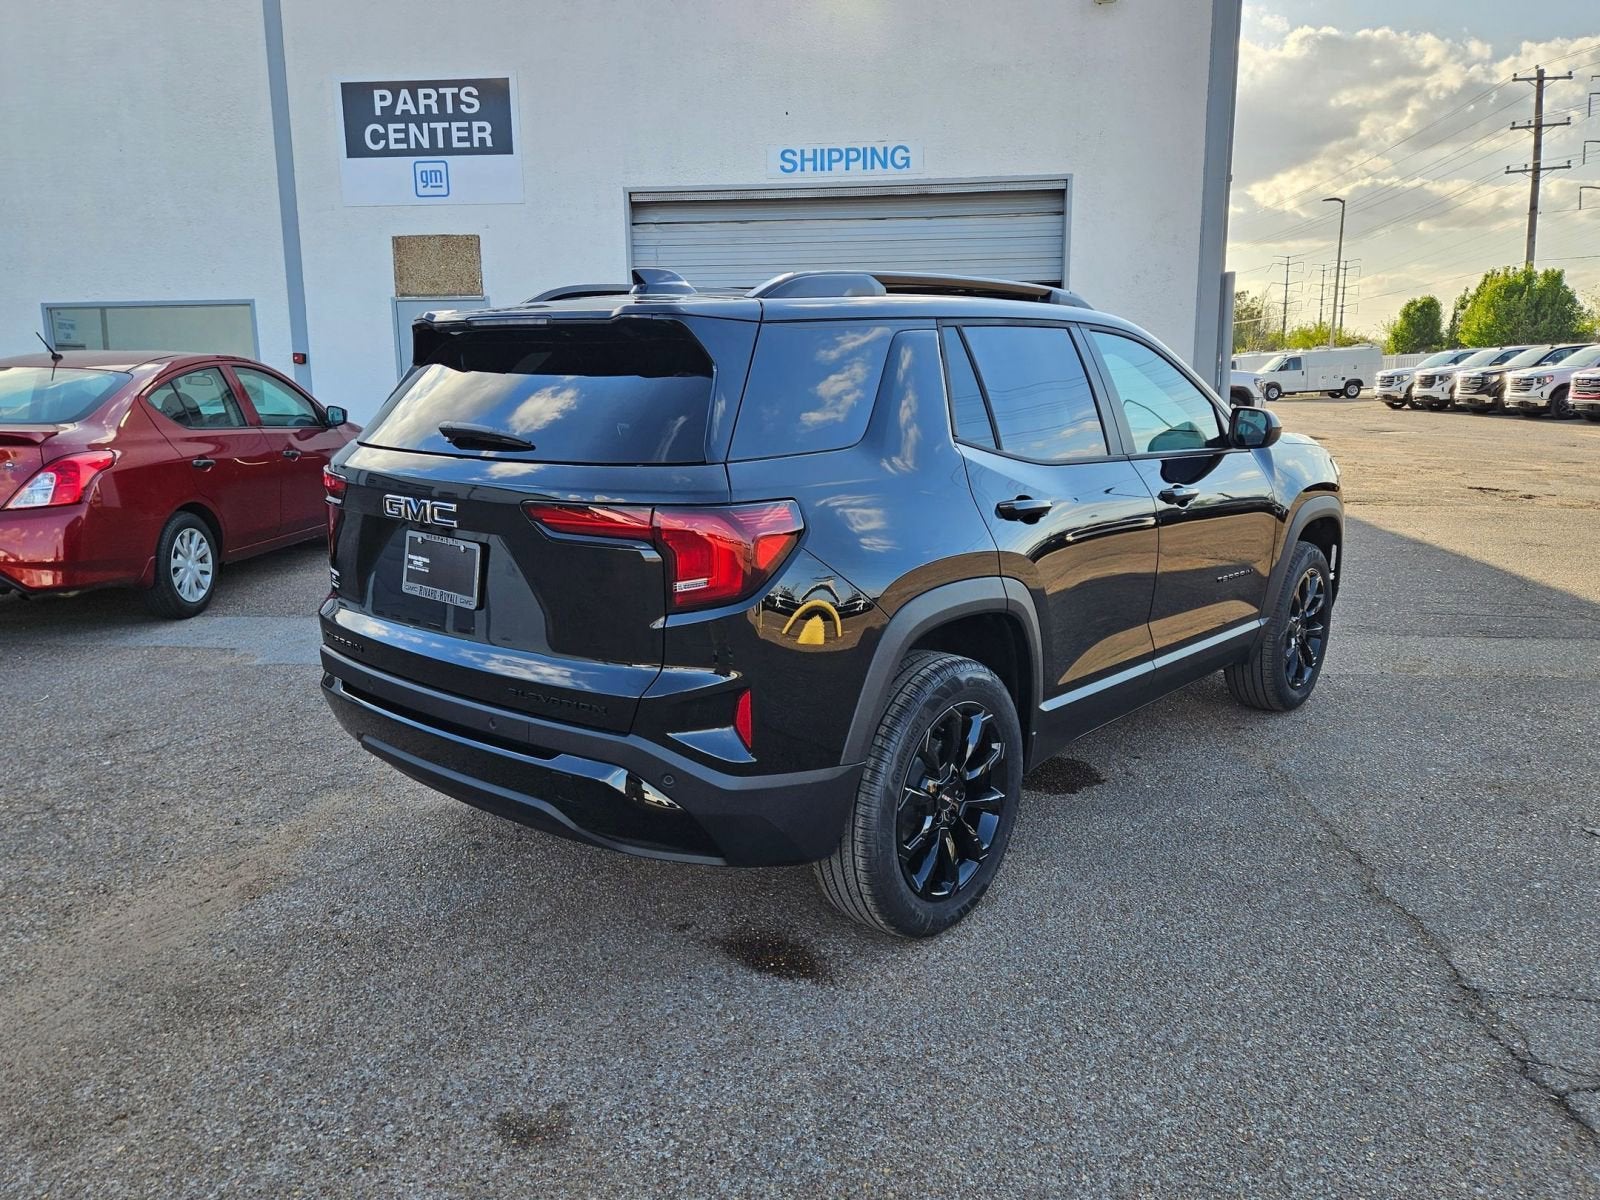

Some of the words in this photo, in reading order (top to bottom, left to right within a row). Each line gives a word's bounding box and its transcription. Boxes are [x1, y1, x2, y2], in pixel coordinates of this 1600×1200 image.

[373, 86, 481, 116] PARTS
[364, 121, 493, 151] CENTER
[779, 144, 911, 174] SHIPPING
[420, 169, 443, 188] gm
[383, 494, 458, 528] GMC
